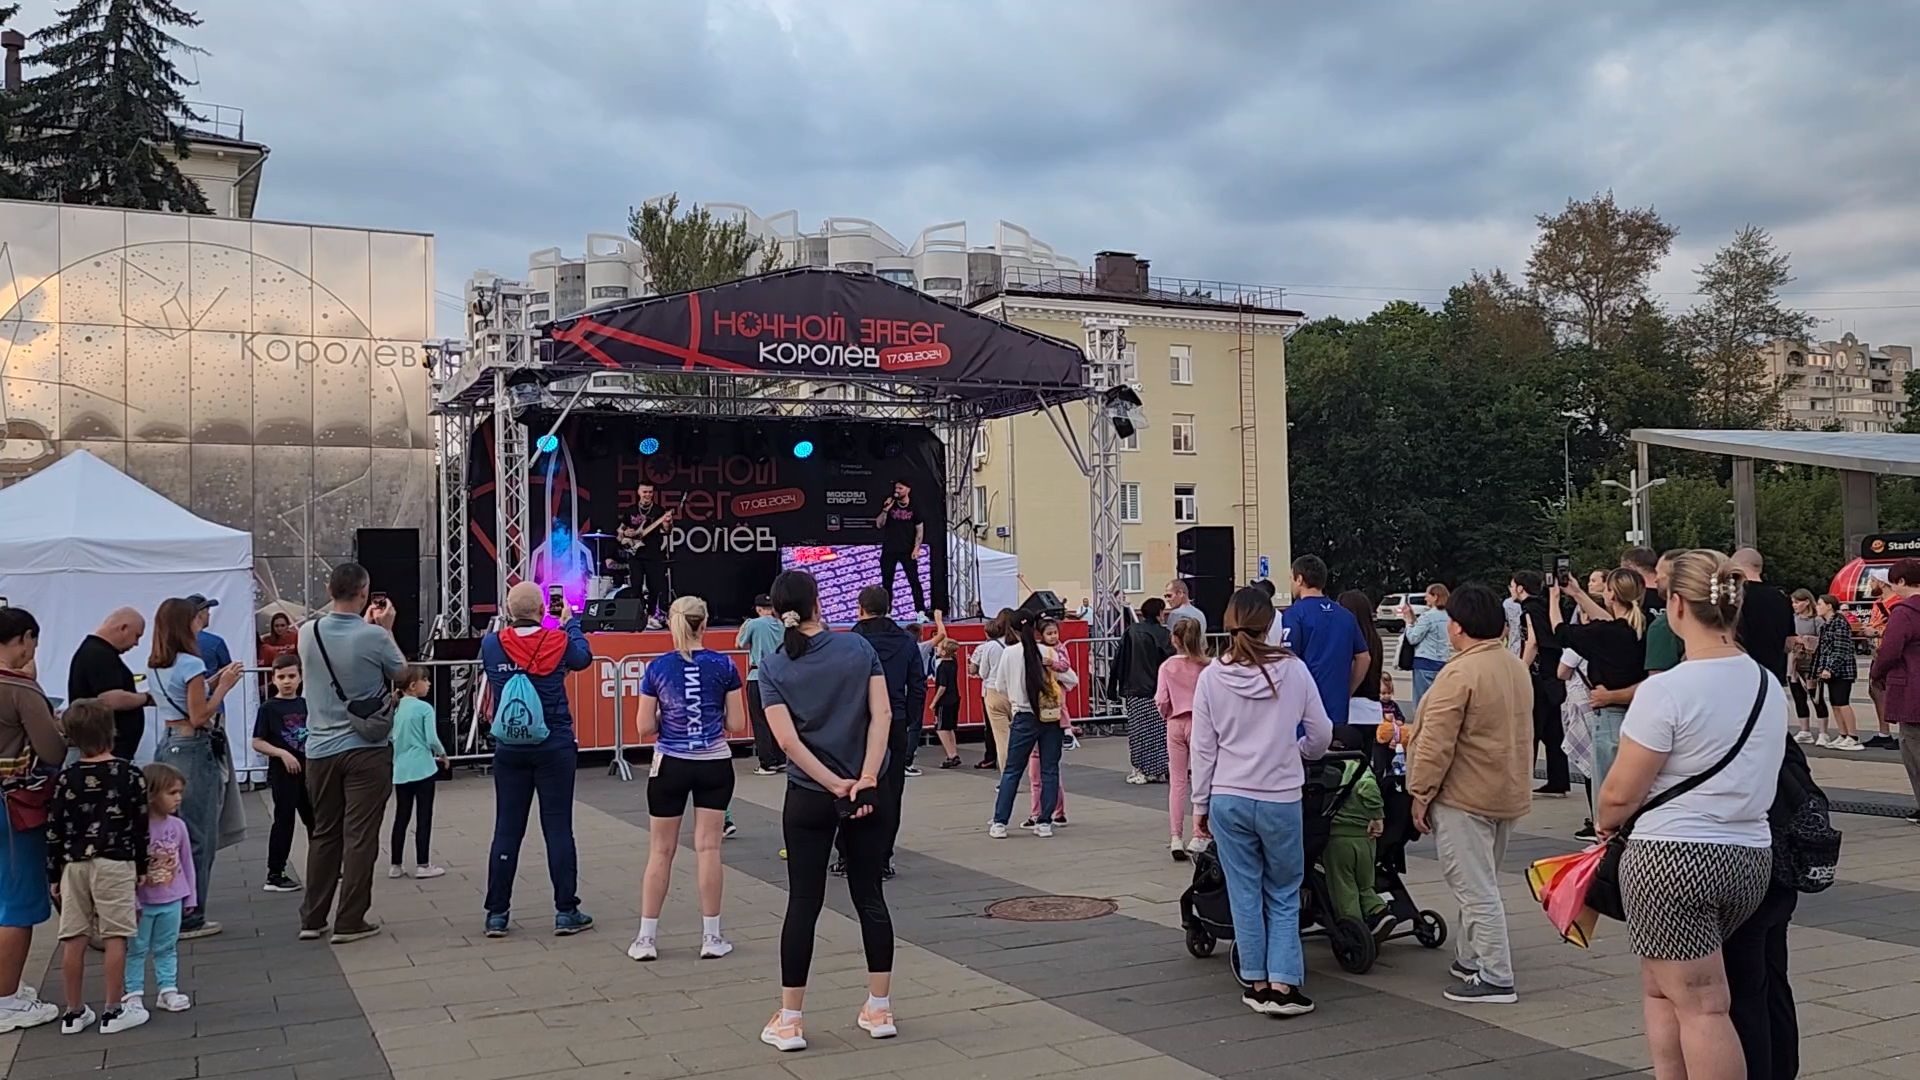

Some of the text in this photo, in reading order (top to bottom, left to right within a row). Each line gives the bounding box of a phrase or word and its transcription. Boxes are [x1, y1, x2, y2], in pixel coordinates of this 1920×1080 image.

[714, 310, 845, 342] НОЧНОЙ
[240, 330, 417, 370] Королёв
[758, 342, 943, 368] КОРОЛЁВ 17.08.2024
[618, 490, 731, 521] ЗБЕГ
[740, 494, 797, 512] 17.08.2024
